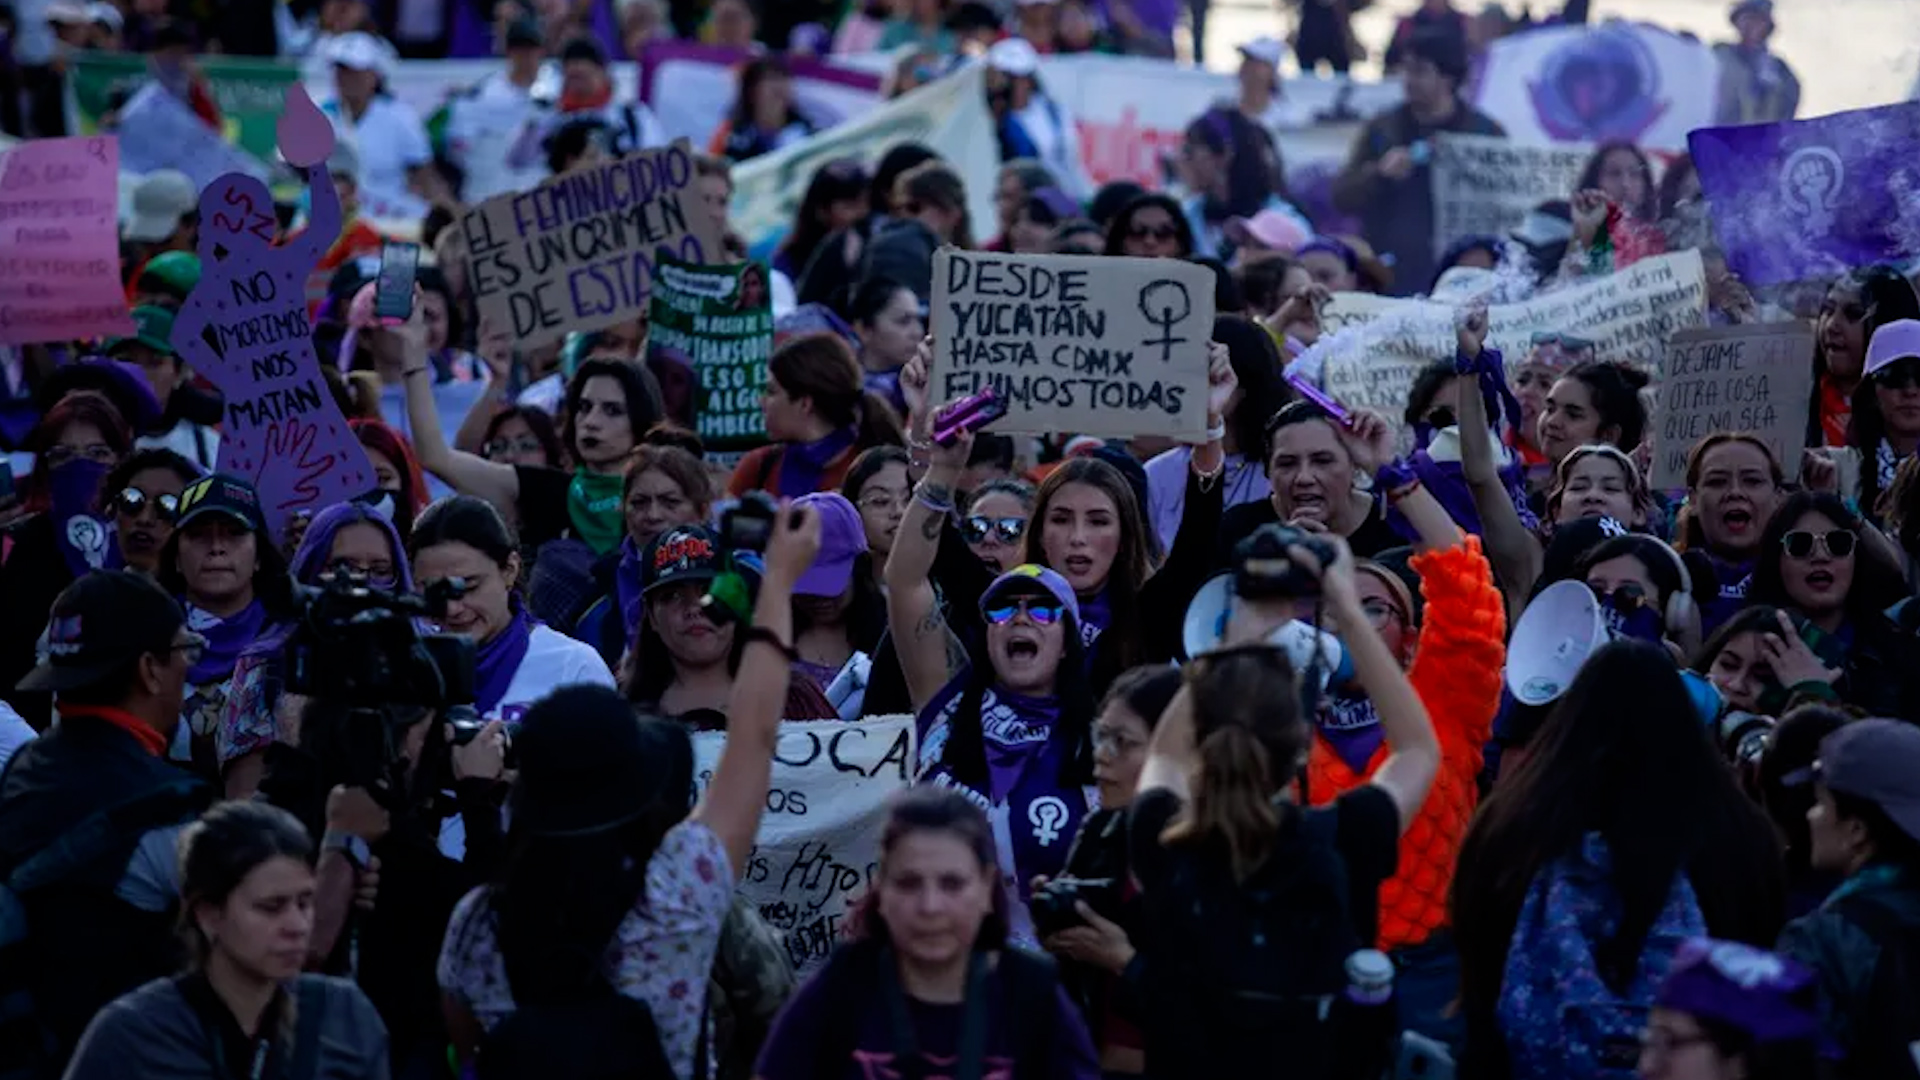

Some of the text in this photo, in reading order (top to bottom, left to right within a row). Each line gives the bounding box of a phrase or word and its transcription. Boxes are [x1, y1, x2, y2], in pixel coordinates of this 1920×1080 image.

[463, 147, 690, 254] EL FEMINICIDIO
[472, 193, 688, 296] ES UN CRIMEN
[230, 271, 275, 306] NO
[508, 279, 563, 339] DE
[568, 235, 704, 319] ESTAO
[947, 255, 1089, 302] DESDE
[218, 307, 310, 352] MORIMOS
[252, 350, 297, 381] NOS
[702, 363, 746, 389] ESO
[950, 336, 1134, 376] HASTA CDMX
[1671, 341, 1746, 376] DEJAME
[228, 379, 321, 430] MATAN
[1669, 374, 1770, 411] OTRA COSA
[1664, 405, 1778, 440] QUE NO SEA
